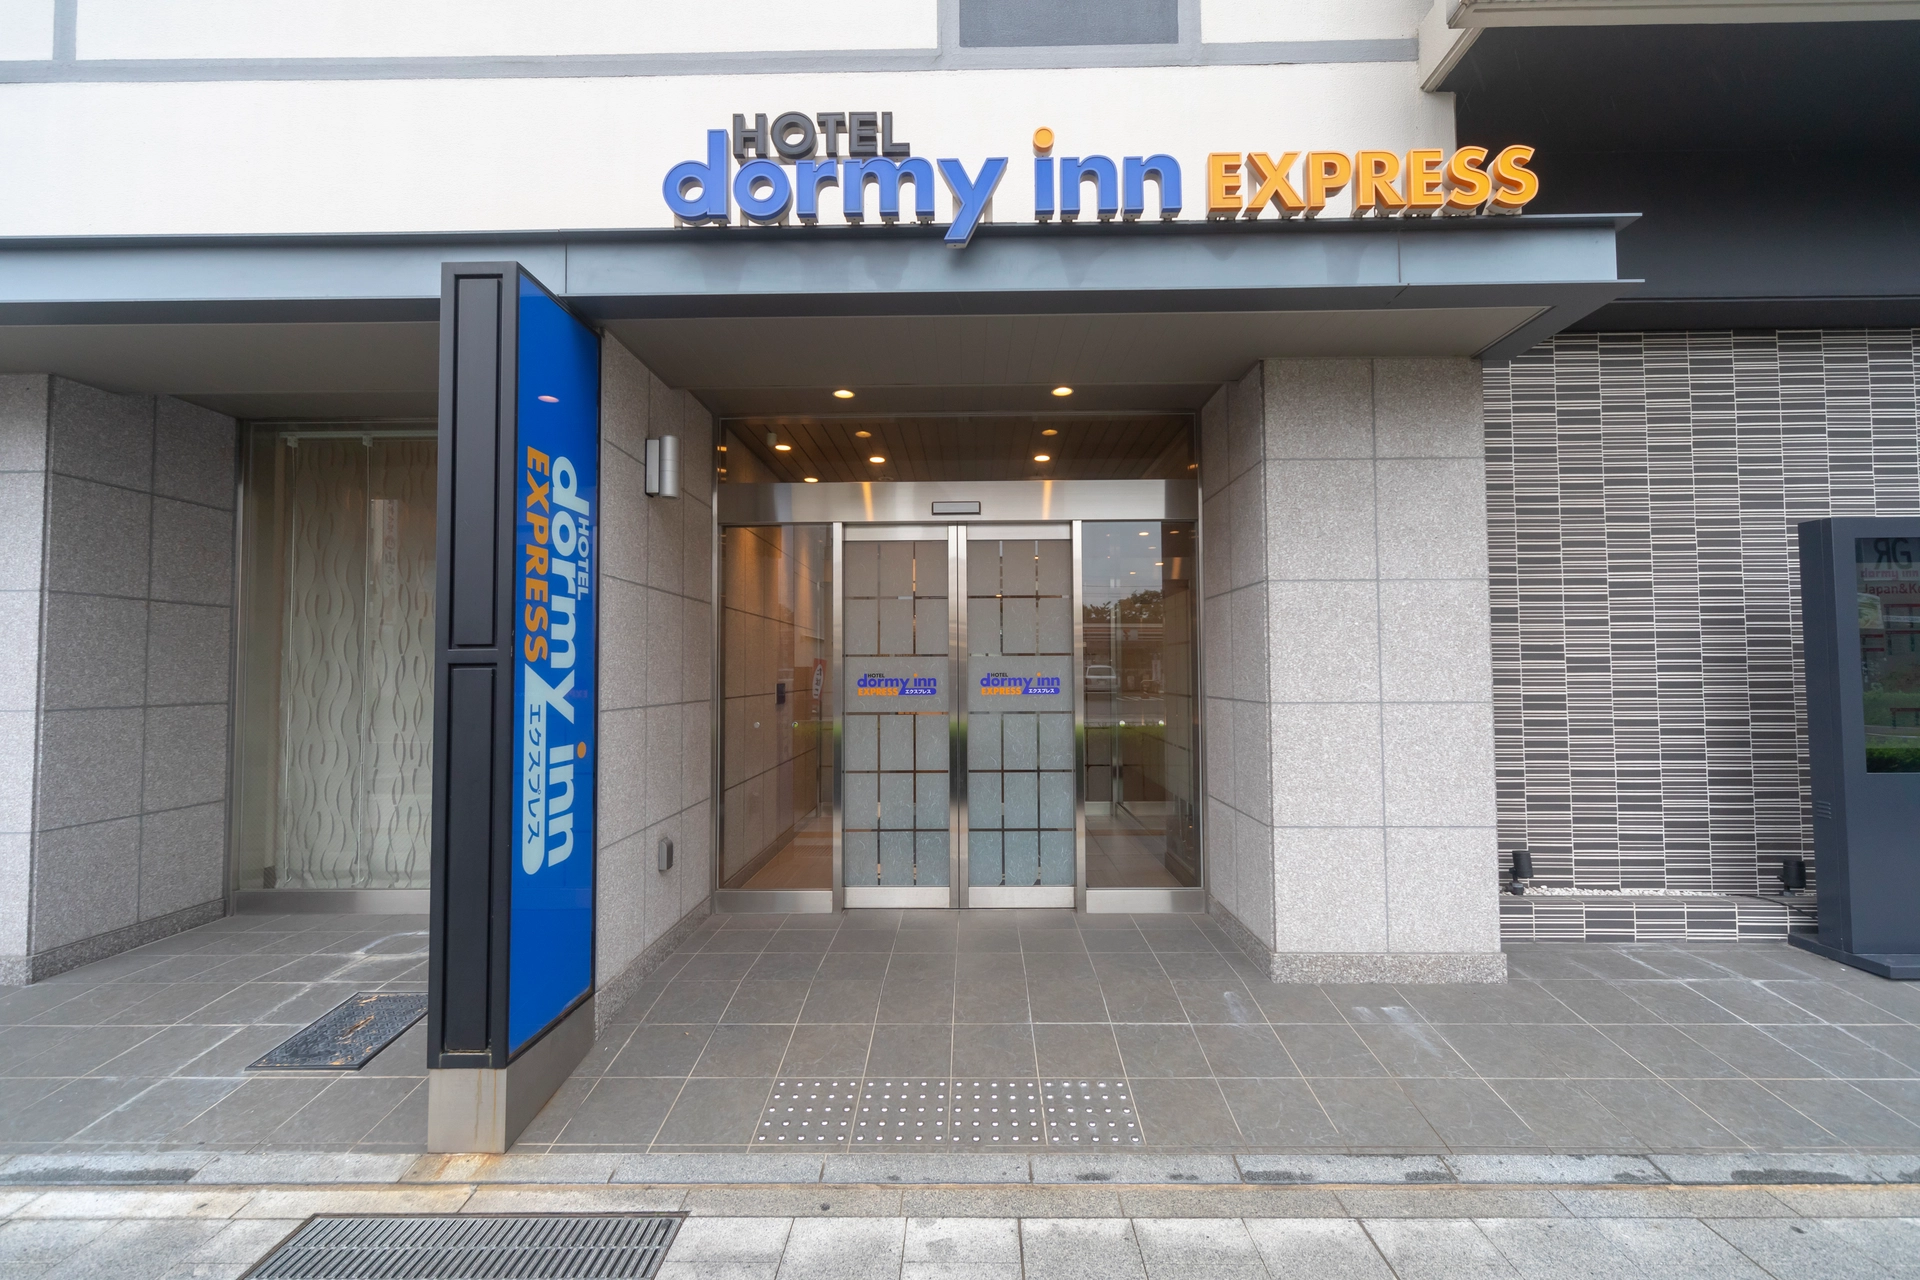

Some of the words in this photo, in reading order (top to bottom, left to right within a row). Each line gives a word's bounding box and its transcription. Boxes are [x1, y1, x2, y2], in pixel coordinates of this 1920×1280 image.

[733, 111, 910, 160] HOTEL
[662, 128, 1009, 247] dormy
[1033, 126, 1182, 219] inn
[1206, 144, 1539, 217] EXPRESS
[524, 445, 550, 663] EXPRESS
[524, 456, 590, 724] dormy
[577, 516, 590, 601] HOTEL
[857, 673, 910, 695] dormy
[913, 673, 937, 687] inn
[857, 688, 899, 696] EXPRESS
[980, 672, 1033, 694] dormy
[1036, 672, 1060, 686] inn
[981, 687, 1022, 695] EXPRESS
[527, 703, 542, 845] エクスプレス
[548, 741, 587, 868] inn
